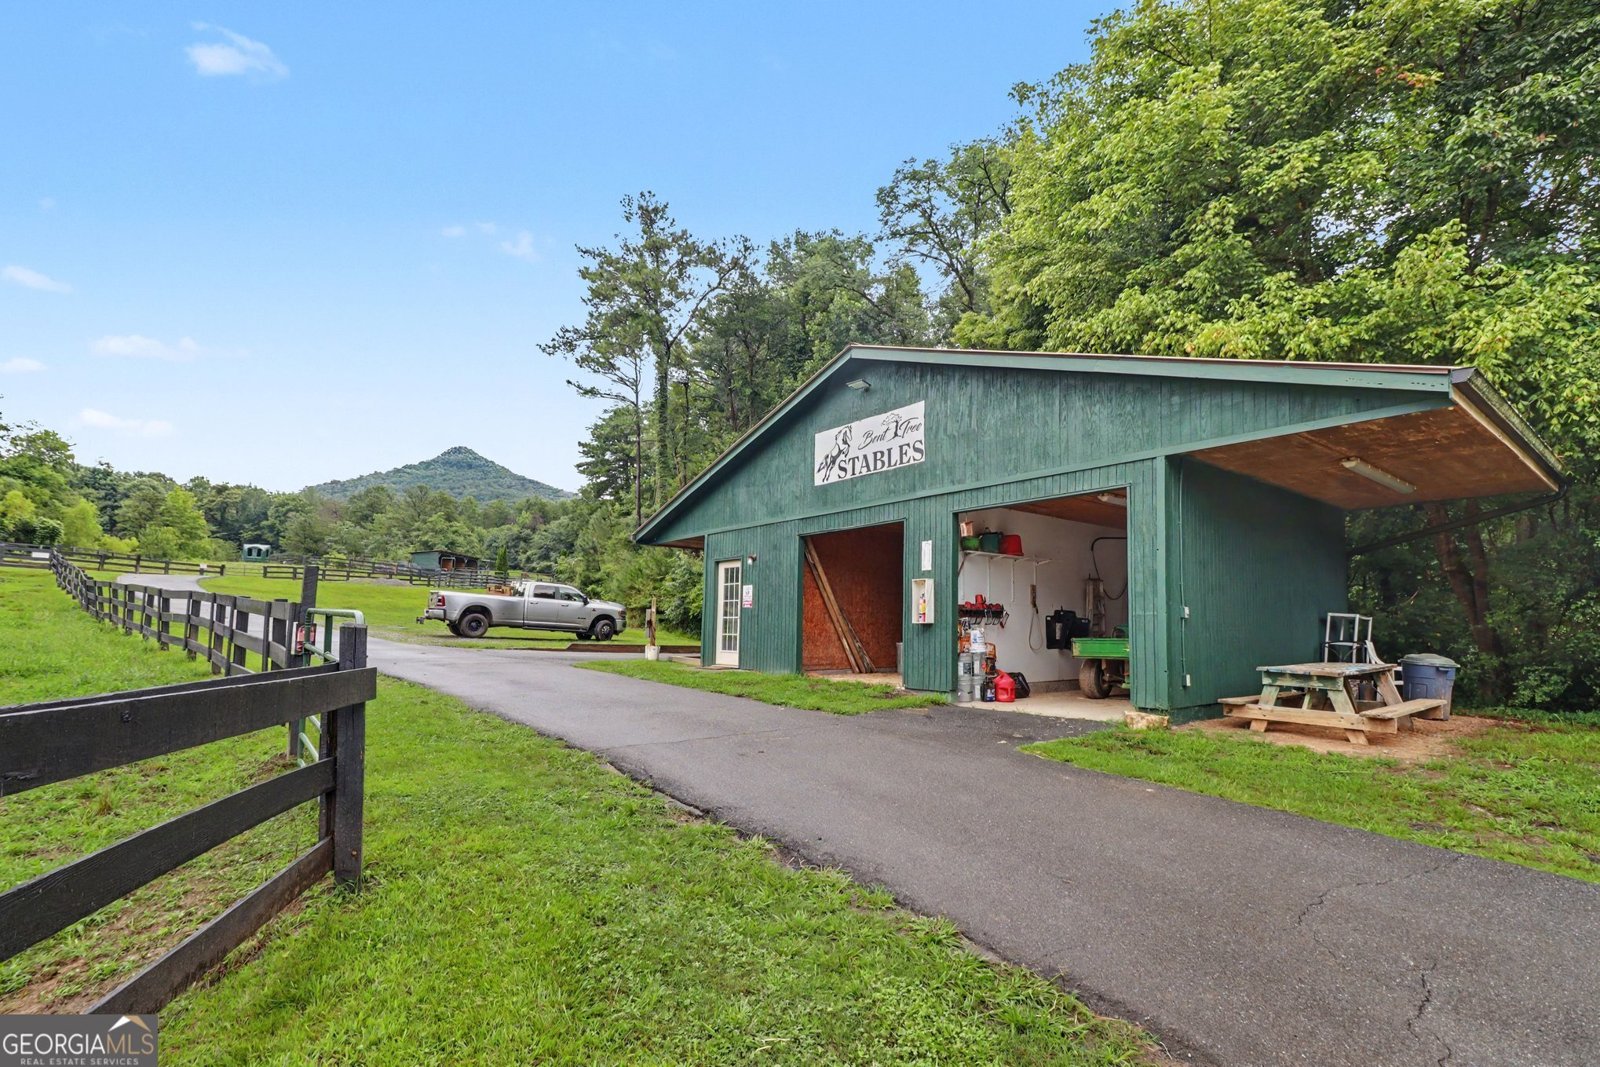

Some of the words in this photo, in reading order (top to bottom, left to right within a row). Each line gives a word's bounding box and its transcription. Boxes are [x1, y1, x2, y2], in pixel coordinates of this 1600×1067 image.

[858, 427, 891, 450] Bent
[899, 417, 922, 438] Tree
[837, 439, 924, 479] STABLES
